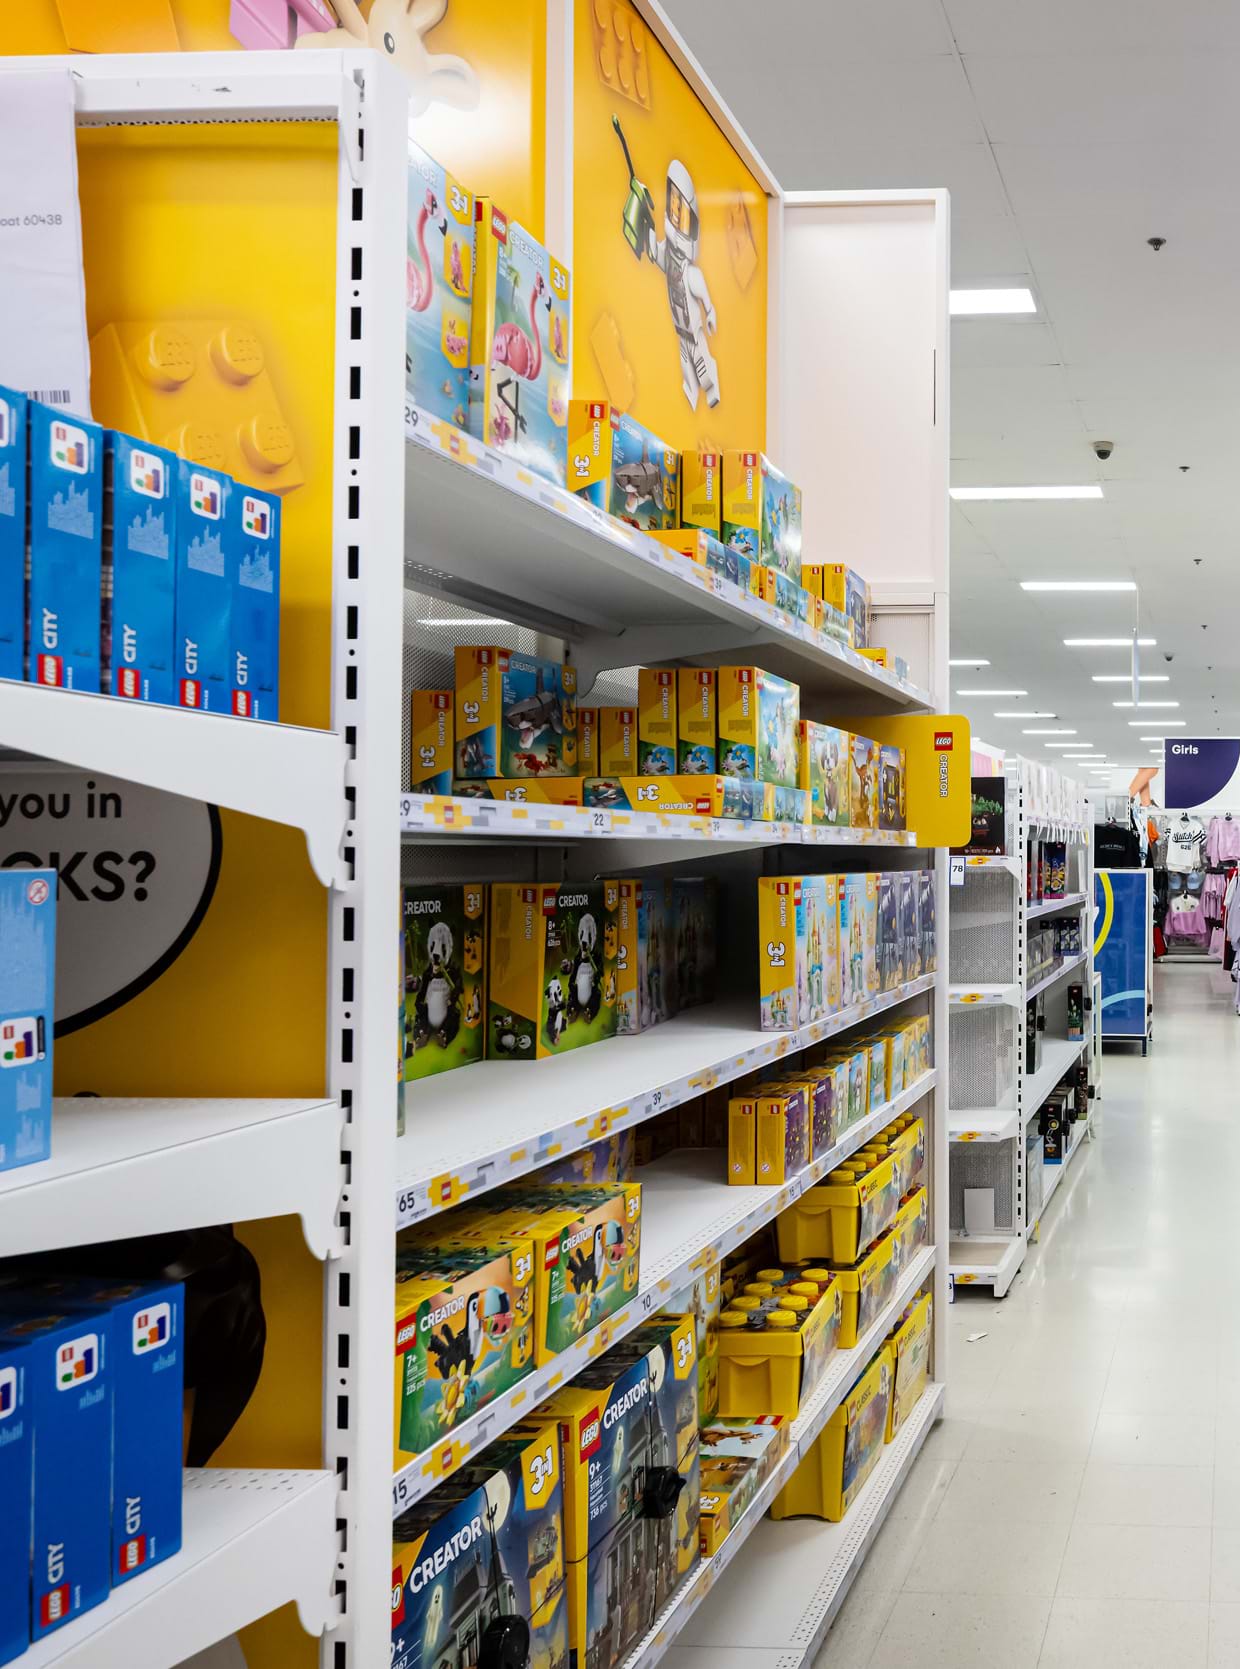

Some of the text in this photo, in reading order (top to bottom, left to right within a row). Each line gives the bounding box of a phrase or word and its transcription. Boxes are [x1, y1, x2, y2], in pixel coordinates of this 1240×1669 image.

[23, 214, 63, 227] 60438
[510, 230, 544, 271] CREATOR
[42, 607, 58, 684] LEGO CITY
[123, 624, 137, 697] LEGO CITY
[185, 637, 199, 706] LEGO CITY
[236, 651, 249, 715] LEGO CITY
[661, 687, 669, 720] CREATOR
[583, 726, 591, 759] CREATOR
[1171, 744, 1200, 756] Girls
[935, 736, 952, 798] LEGO CREATOR
[0, 781, 122, 828] you in
[594, 812, 604, 826] 22
[952, 865, 963, 873] 78
[559, 894, 588, 908] CREATOR
[779, 896, 787, 927] CREATOR
[652, 1091, 662, 1106] 39
[399, 1191, 416, 1212] 65
[545, 1226, 593, 1260] LEGO CREATOR
[397, 1296, 466, 1345] LEGO CREATOR
[580, 1378, 648, 1450] LEGO CREATOR
[855, 1385, 872, 1413] CLASSIC
[589, 1460, 601, 1481] 9+
[392, 1478, 408, 1504] 15
[125, 1496, 141, 1570] LEGO CITY
[408, 1516, 483, 1595] CREATOR
[47, 1541, 64, 1621] LEGO CITY
